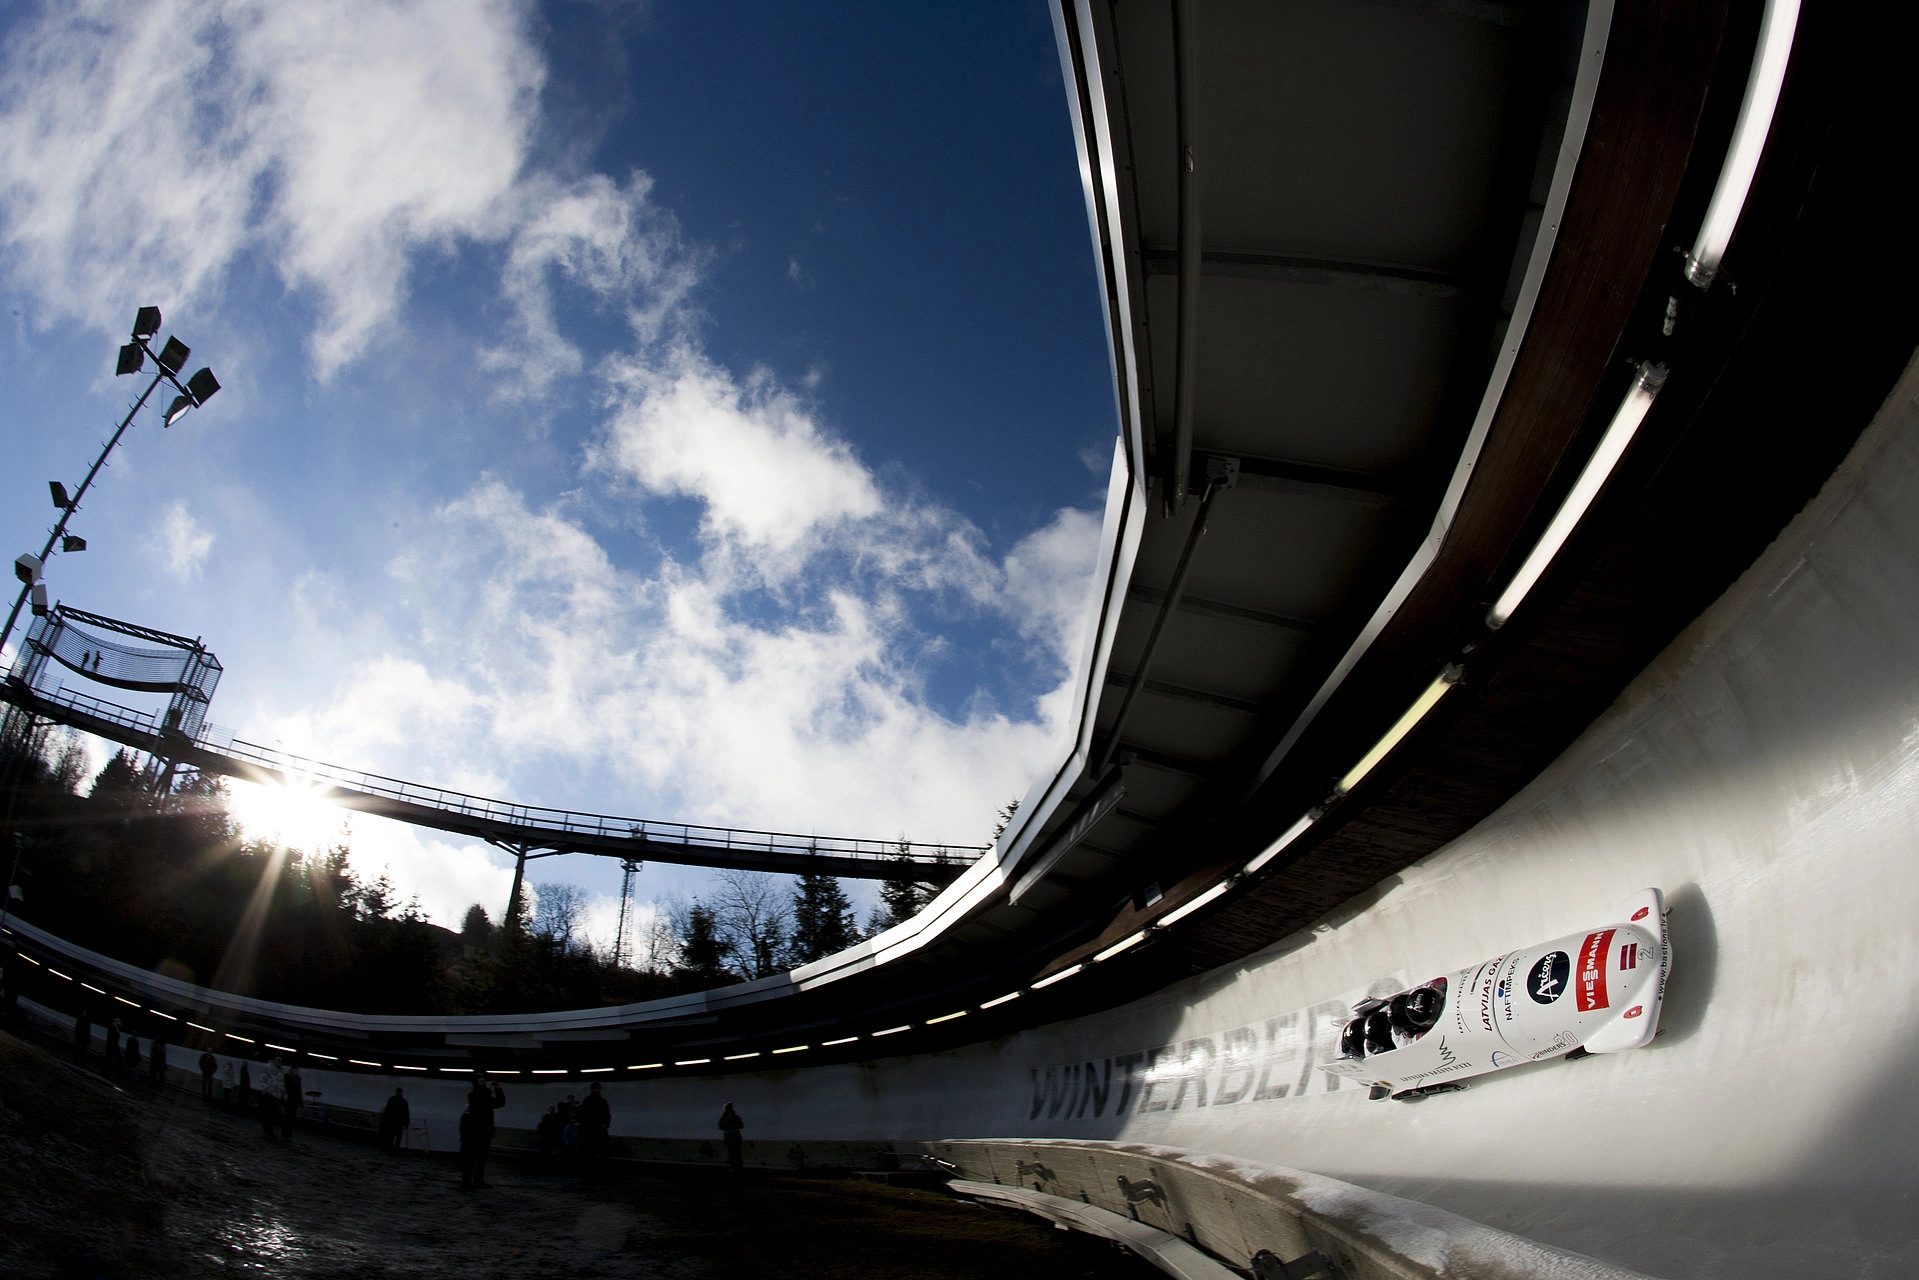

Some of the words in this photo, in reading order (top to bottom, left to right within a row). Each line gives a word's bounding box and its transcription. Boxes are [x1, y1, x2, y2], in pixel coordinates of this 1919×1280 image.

[1582, 932, 1605, 1009] VIESSMANN
[1636, 946, 1654, 961] 2
[1658, 918, 1668, 995] www.bastions.lv
[1481, 978, 1493, 1032] LATVIJAS
